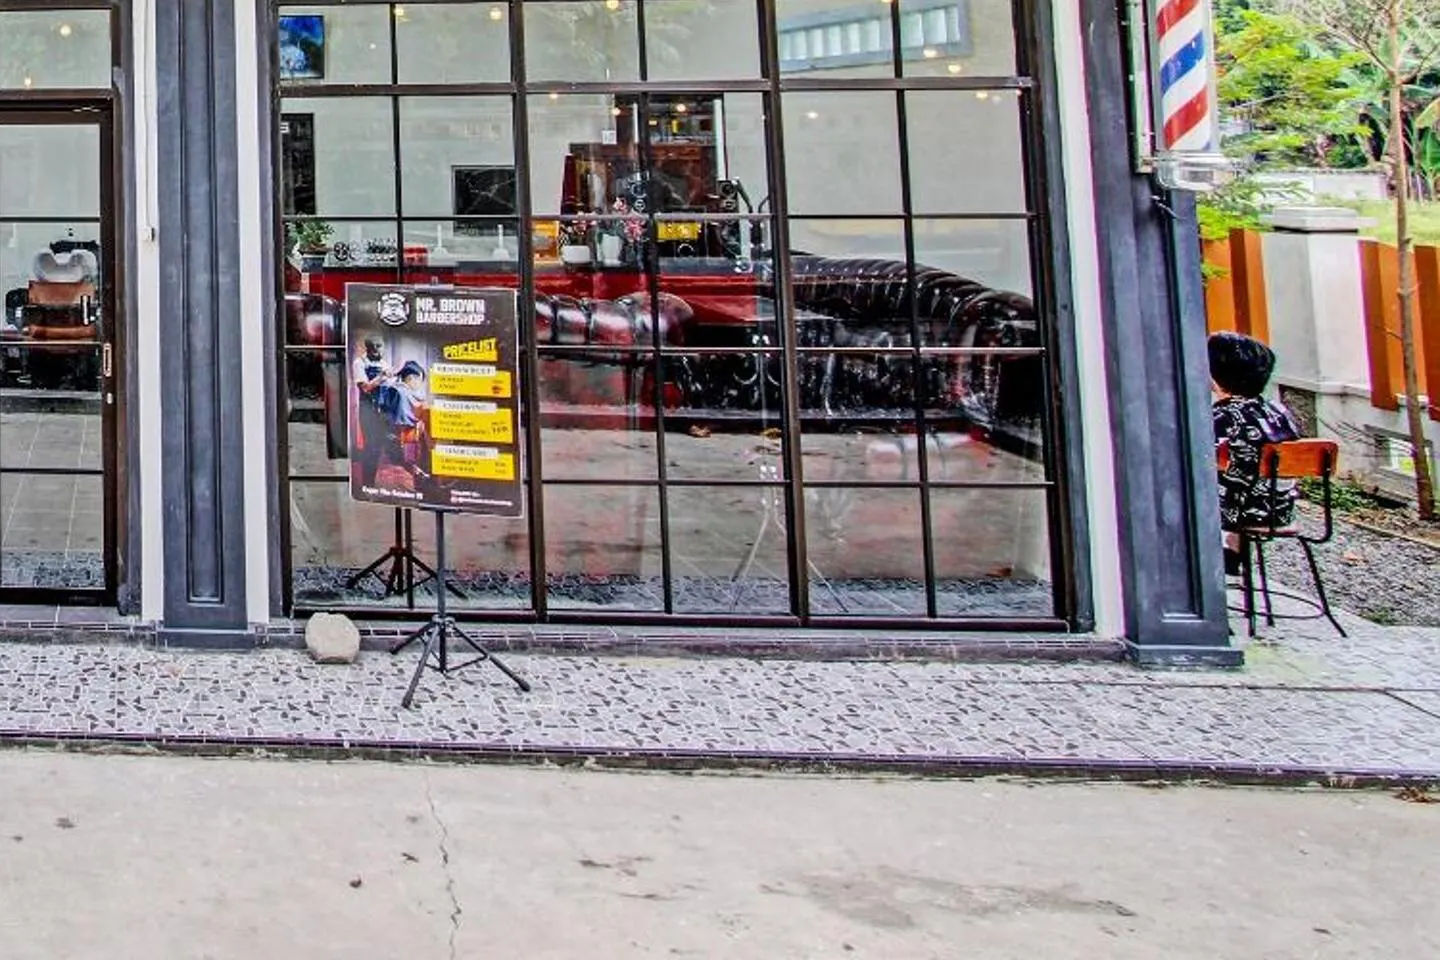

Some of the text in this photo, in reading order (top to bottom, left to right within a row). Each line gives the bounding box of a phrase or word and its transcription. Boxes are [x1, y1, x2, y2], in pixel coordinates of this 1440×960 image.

[416, 297, 436, 311] MR.
[440, 299, 485, 313] BROWN
[416, 311, 485, 325] BARBERSHOP
[443, 338, 497, 358] PRICELIST
